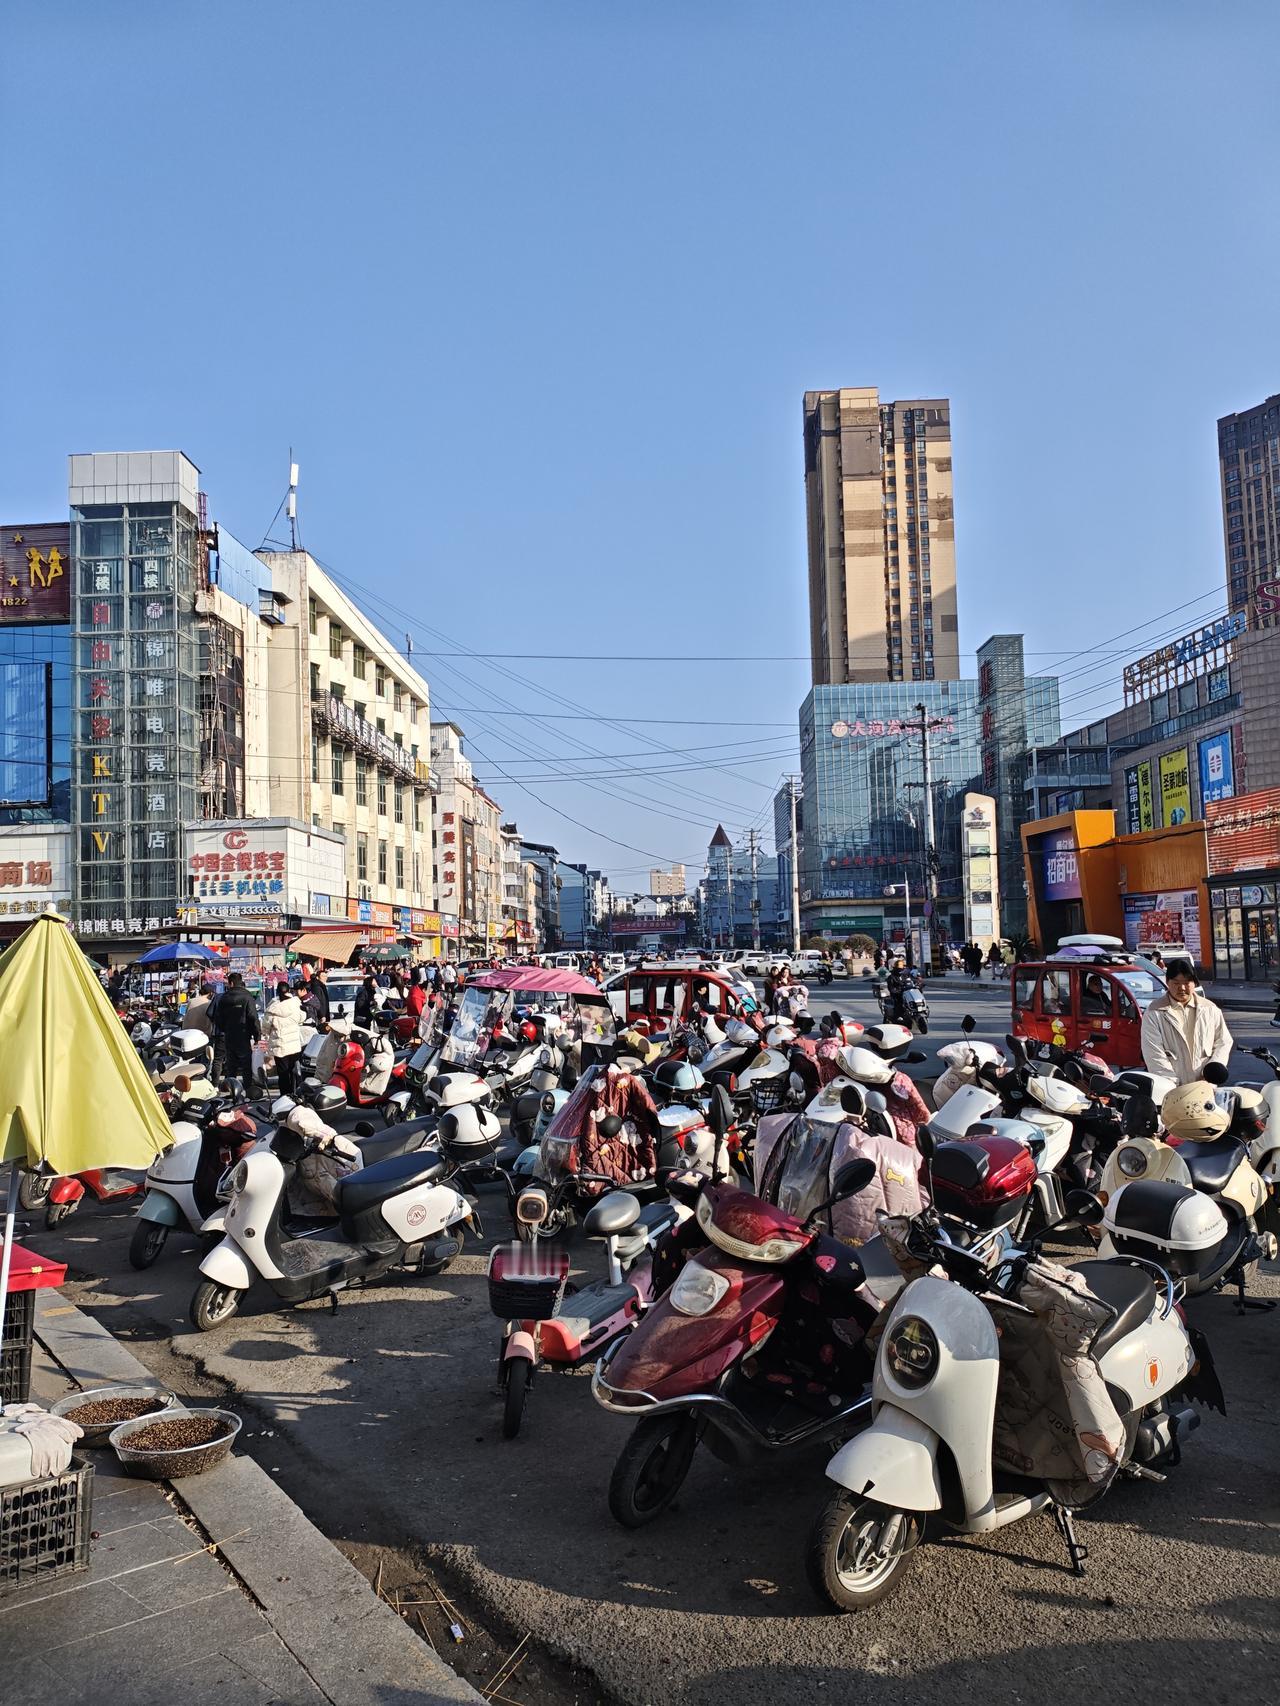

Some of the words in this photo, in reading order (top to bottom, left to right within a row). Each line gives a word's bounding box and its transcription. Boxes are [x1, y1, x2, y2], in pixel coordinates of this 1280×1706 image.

[96, 562, 110, 591] 五楼
[144, 561, 158, 588] 四楼
[91, 602, 112, 739] 自由天空
[145, 639, 166, 849] 锦唯电竞酒店
[92, 756, 113, 853] KTV
[189, 851, 285, 872] 中国金银珠宝
